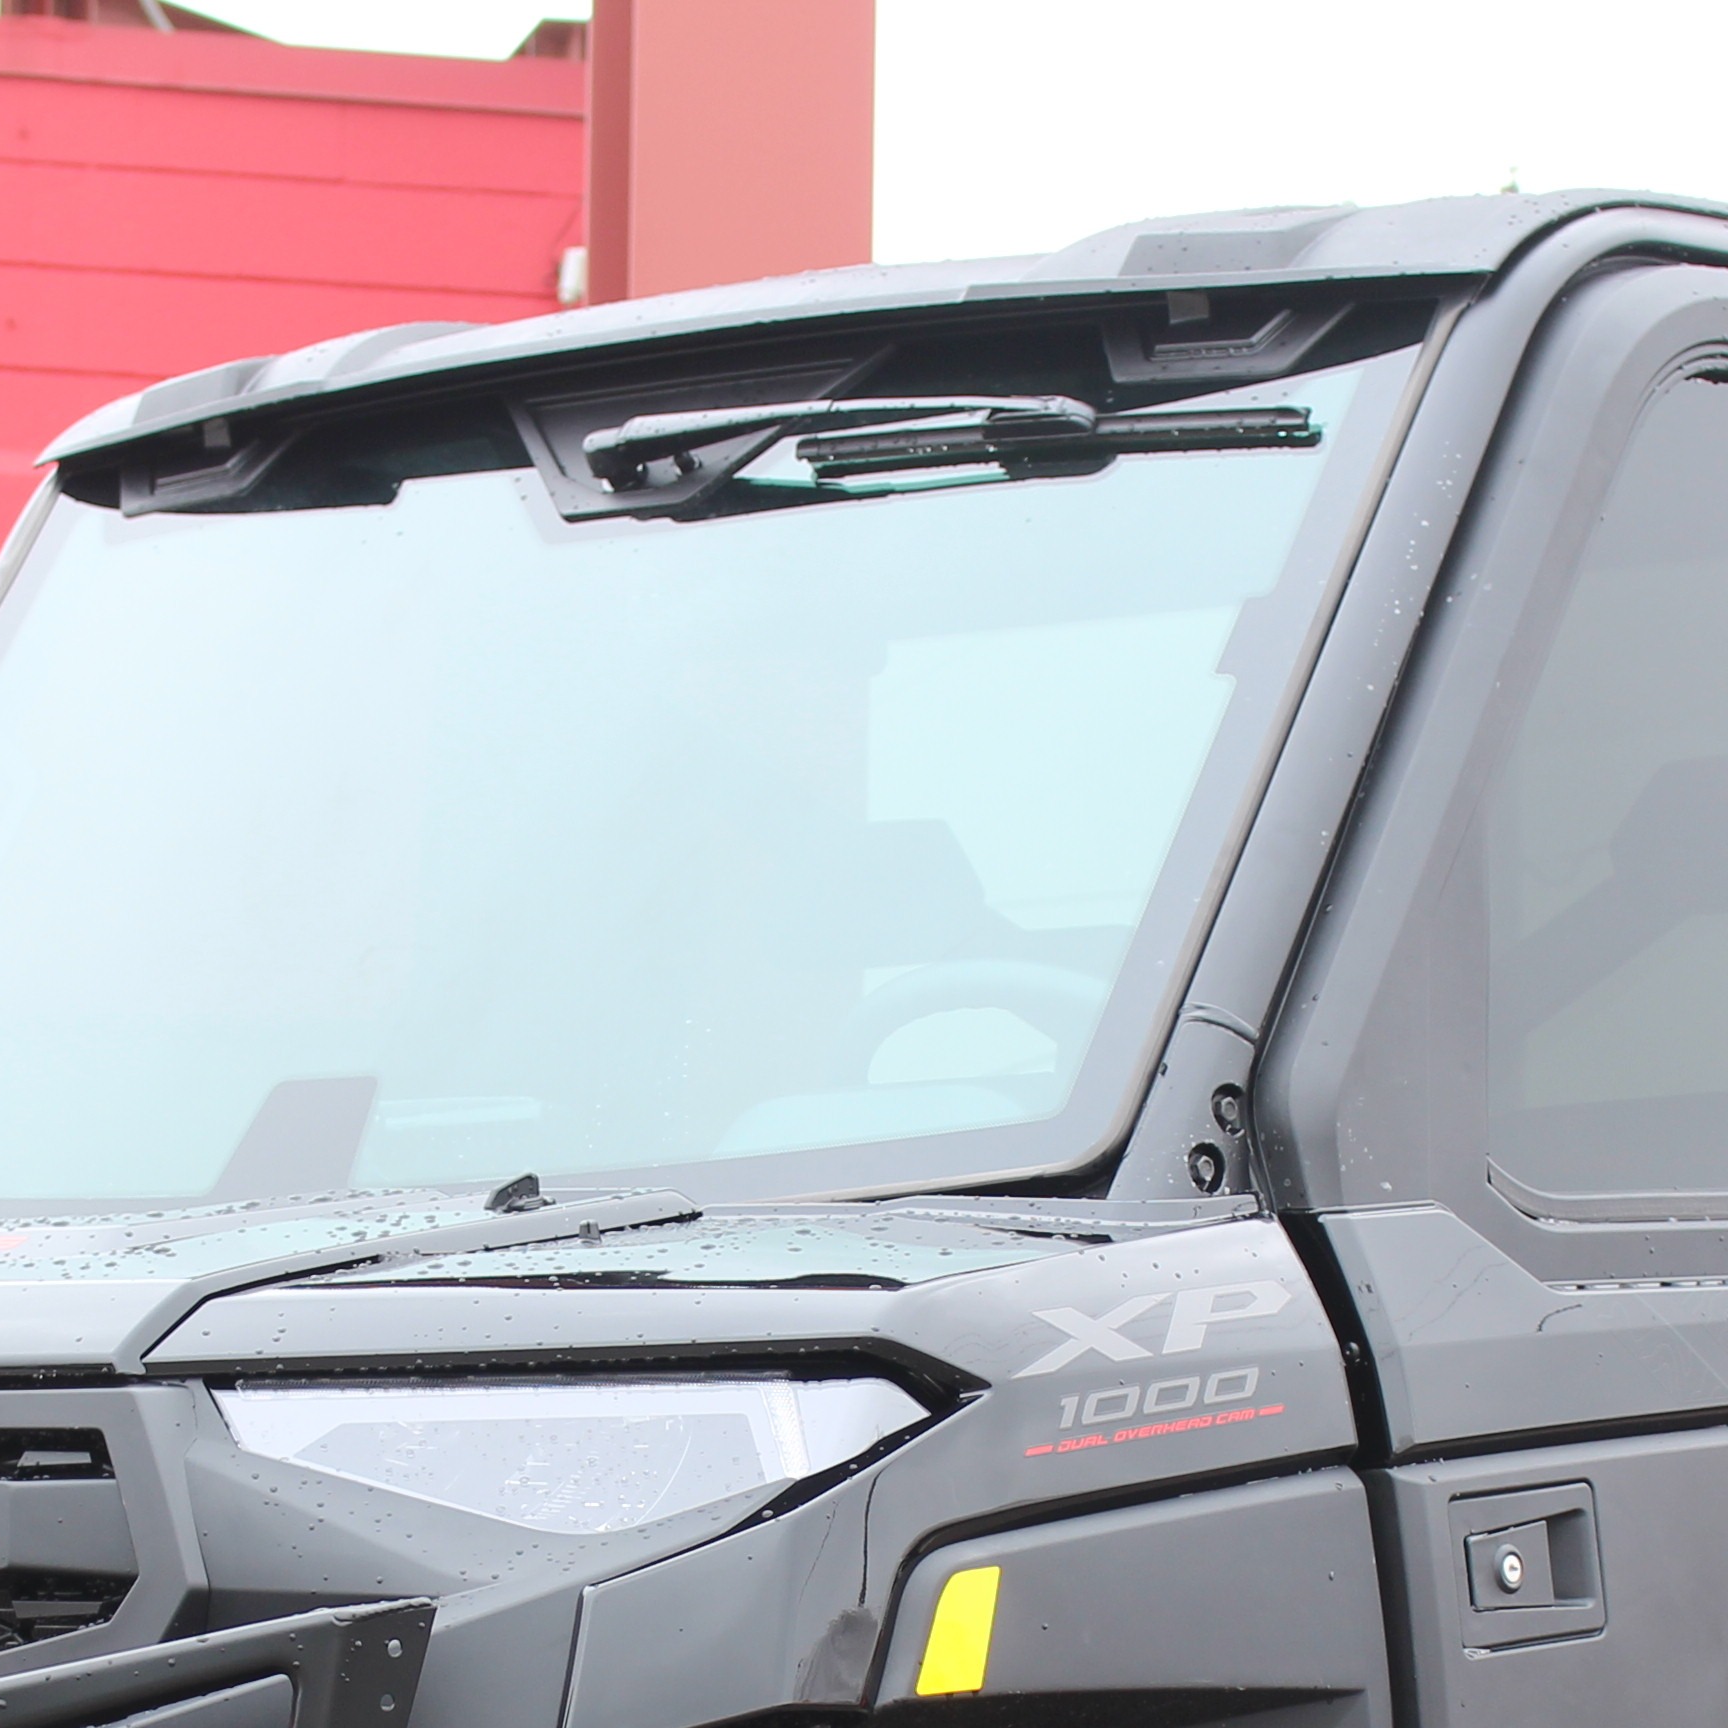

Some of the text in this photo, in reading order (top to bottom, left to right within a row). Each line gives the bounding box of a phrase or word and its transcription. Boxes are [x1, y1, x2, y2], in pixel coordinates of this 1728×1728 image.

[1012, 1281, 1291, 1379] XP
[1056, 1407, 1257, 1453] DUAL OVERHEAD CAM
[1058, 1366, 1260, 1430] 1000
